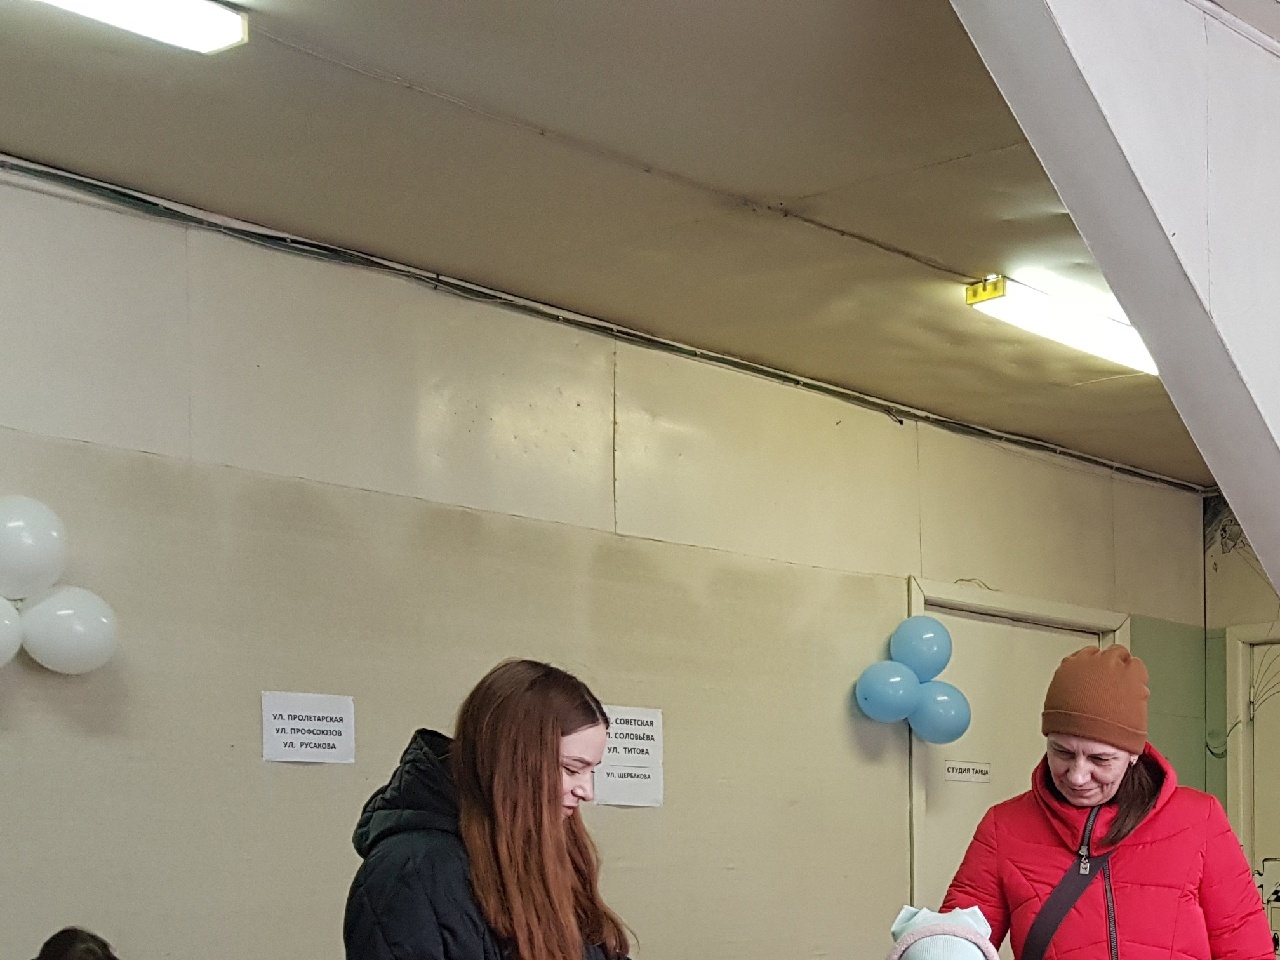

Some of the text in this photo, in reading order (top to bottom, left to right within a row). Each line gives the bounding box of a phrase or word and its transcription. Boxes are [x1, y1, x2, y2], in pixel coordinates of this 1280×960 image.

[272, 713, 344, 723] УЛ. ПРОЛЕТАРСКАЯ
[614, 717, 654, 727] СОВЕТСКАЯ
[290, 727, 342, 737] ПРОФСОЮЗОВ
[283, 741, 296, 749] УЛ.
[607, 746, 650, 755] УЛ. ТИТОВА
